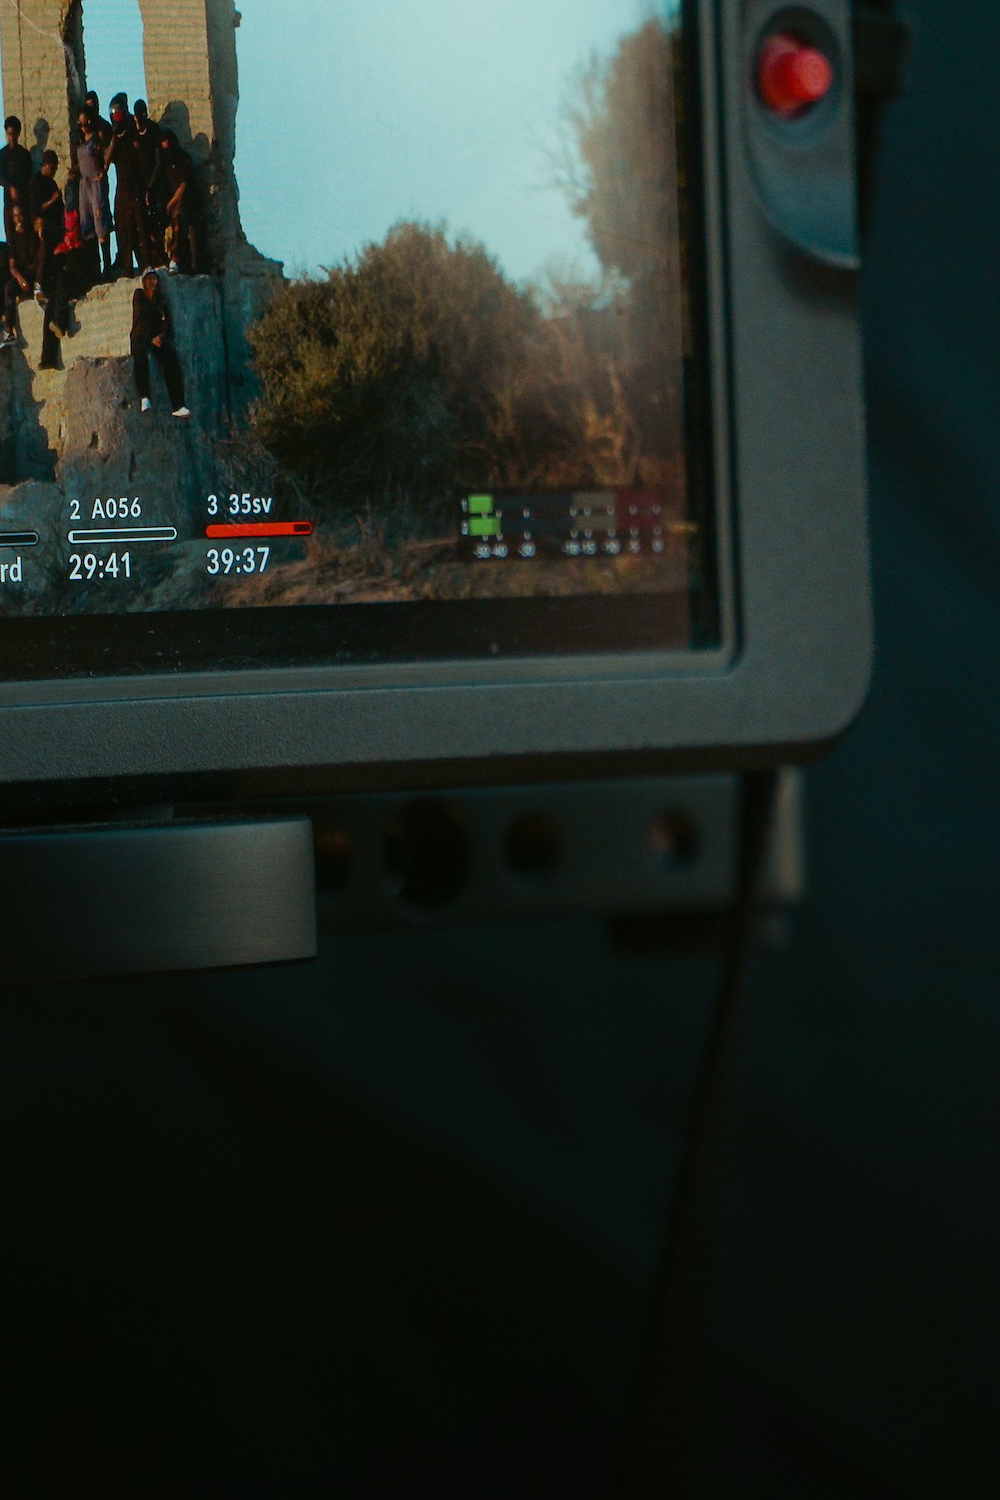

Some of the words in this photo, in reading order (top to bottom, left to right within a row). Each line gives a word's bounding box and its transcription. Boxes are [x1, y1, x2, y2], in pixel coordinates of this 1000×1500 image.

[69, 499, 81, 521] 2
[91, 497, 142, 521] A056
[206, 495, 219, 516] 3
[68, 551, 132, 581] 29:41
[206, 546, 271, 576] 39:37
